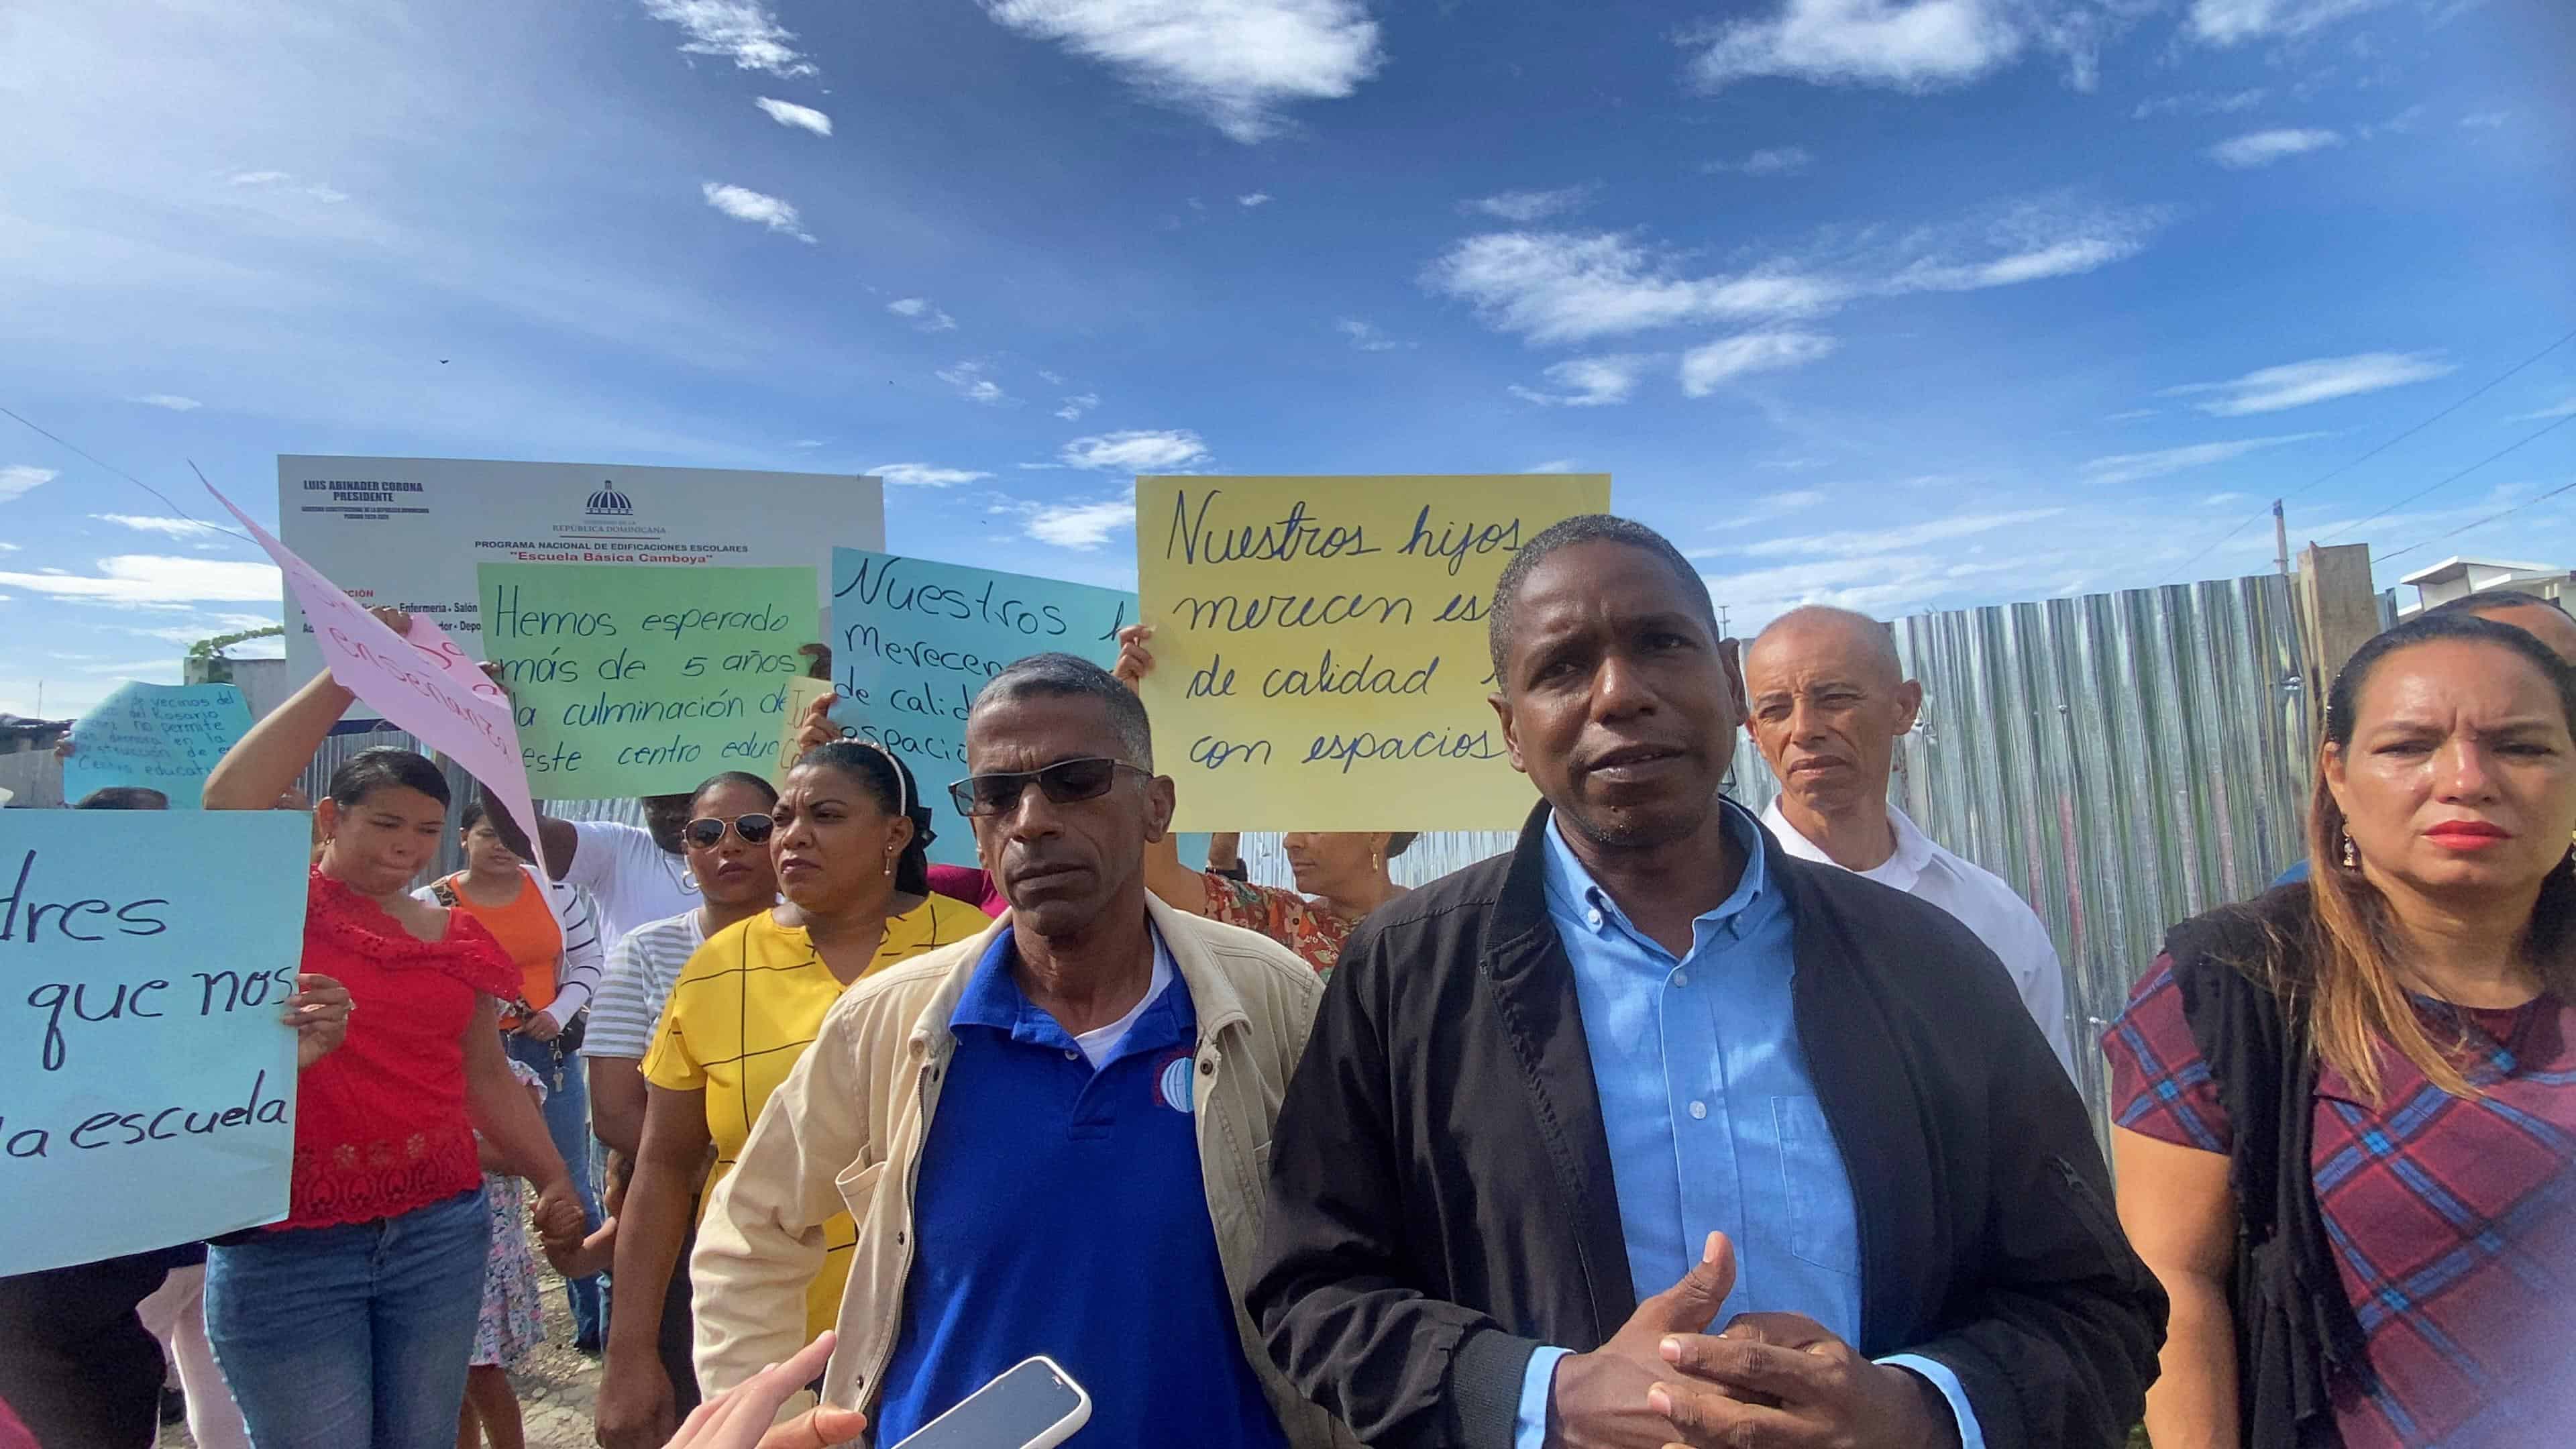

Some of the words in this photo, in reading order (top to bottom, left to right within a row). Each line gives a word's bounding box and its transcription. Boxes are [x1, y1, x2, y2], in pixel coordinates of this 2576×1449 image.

[303, 480, 327, 490] LUIS
[329, 480, 379, 491] ABINADER
[381, 482, 424, 492] CORONA
[333, 492, 394, 502] PRESIDENTE
[474, 541, 536, 549] PROGRAMA
[538, 541, 591, 549] NACIONAL
[610, 543, 688, 552] EDIFICACIONES
[690, 544, 749, 553] ESCOLARES
[605, 525, 666, 534] DOMINICANA
[1167, 490, 1381, 564] Nuestros
[1397, 504, 1523, 576] hijos
[495, 584, 617, 638] Hemos
[641, 602, 789, 641] esperado
[834, 557, 1067, 635] Nuestros
[500, 646, 578, 684] más
[598, 647, 645, 680] de
[682, 657, 708, 677] 5
[722, 649, 797, 674] años
[834, 665, 870, 706] de
[1186, 653, 1236, 699] de
[1263, 649, 1440, 698] calidad
[513, 692, 537, 727] la
[562, 689, 744, 727] culminación
[522, 740, 582, 773] este
[617, 734, 702, 766] centro
[1189, 735, 1273, 769] con
[1301, 726, 1507, 773] espacios
[28, 979, 168, 1071] que
[192, 966, 293, 1016] nos
[70, 1069, 288, 1149] escuela
